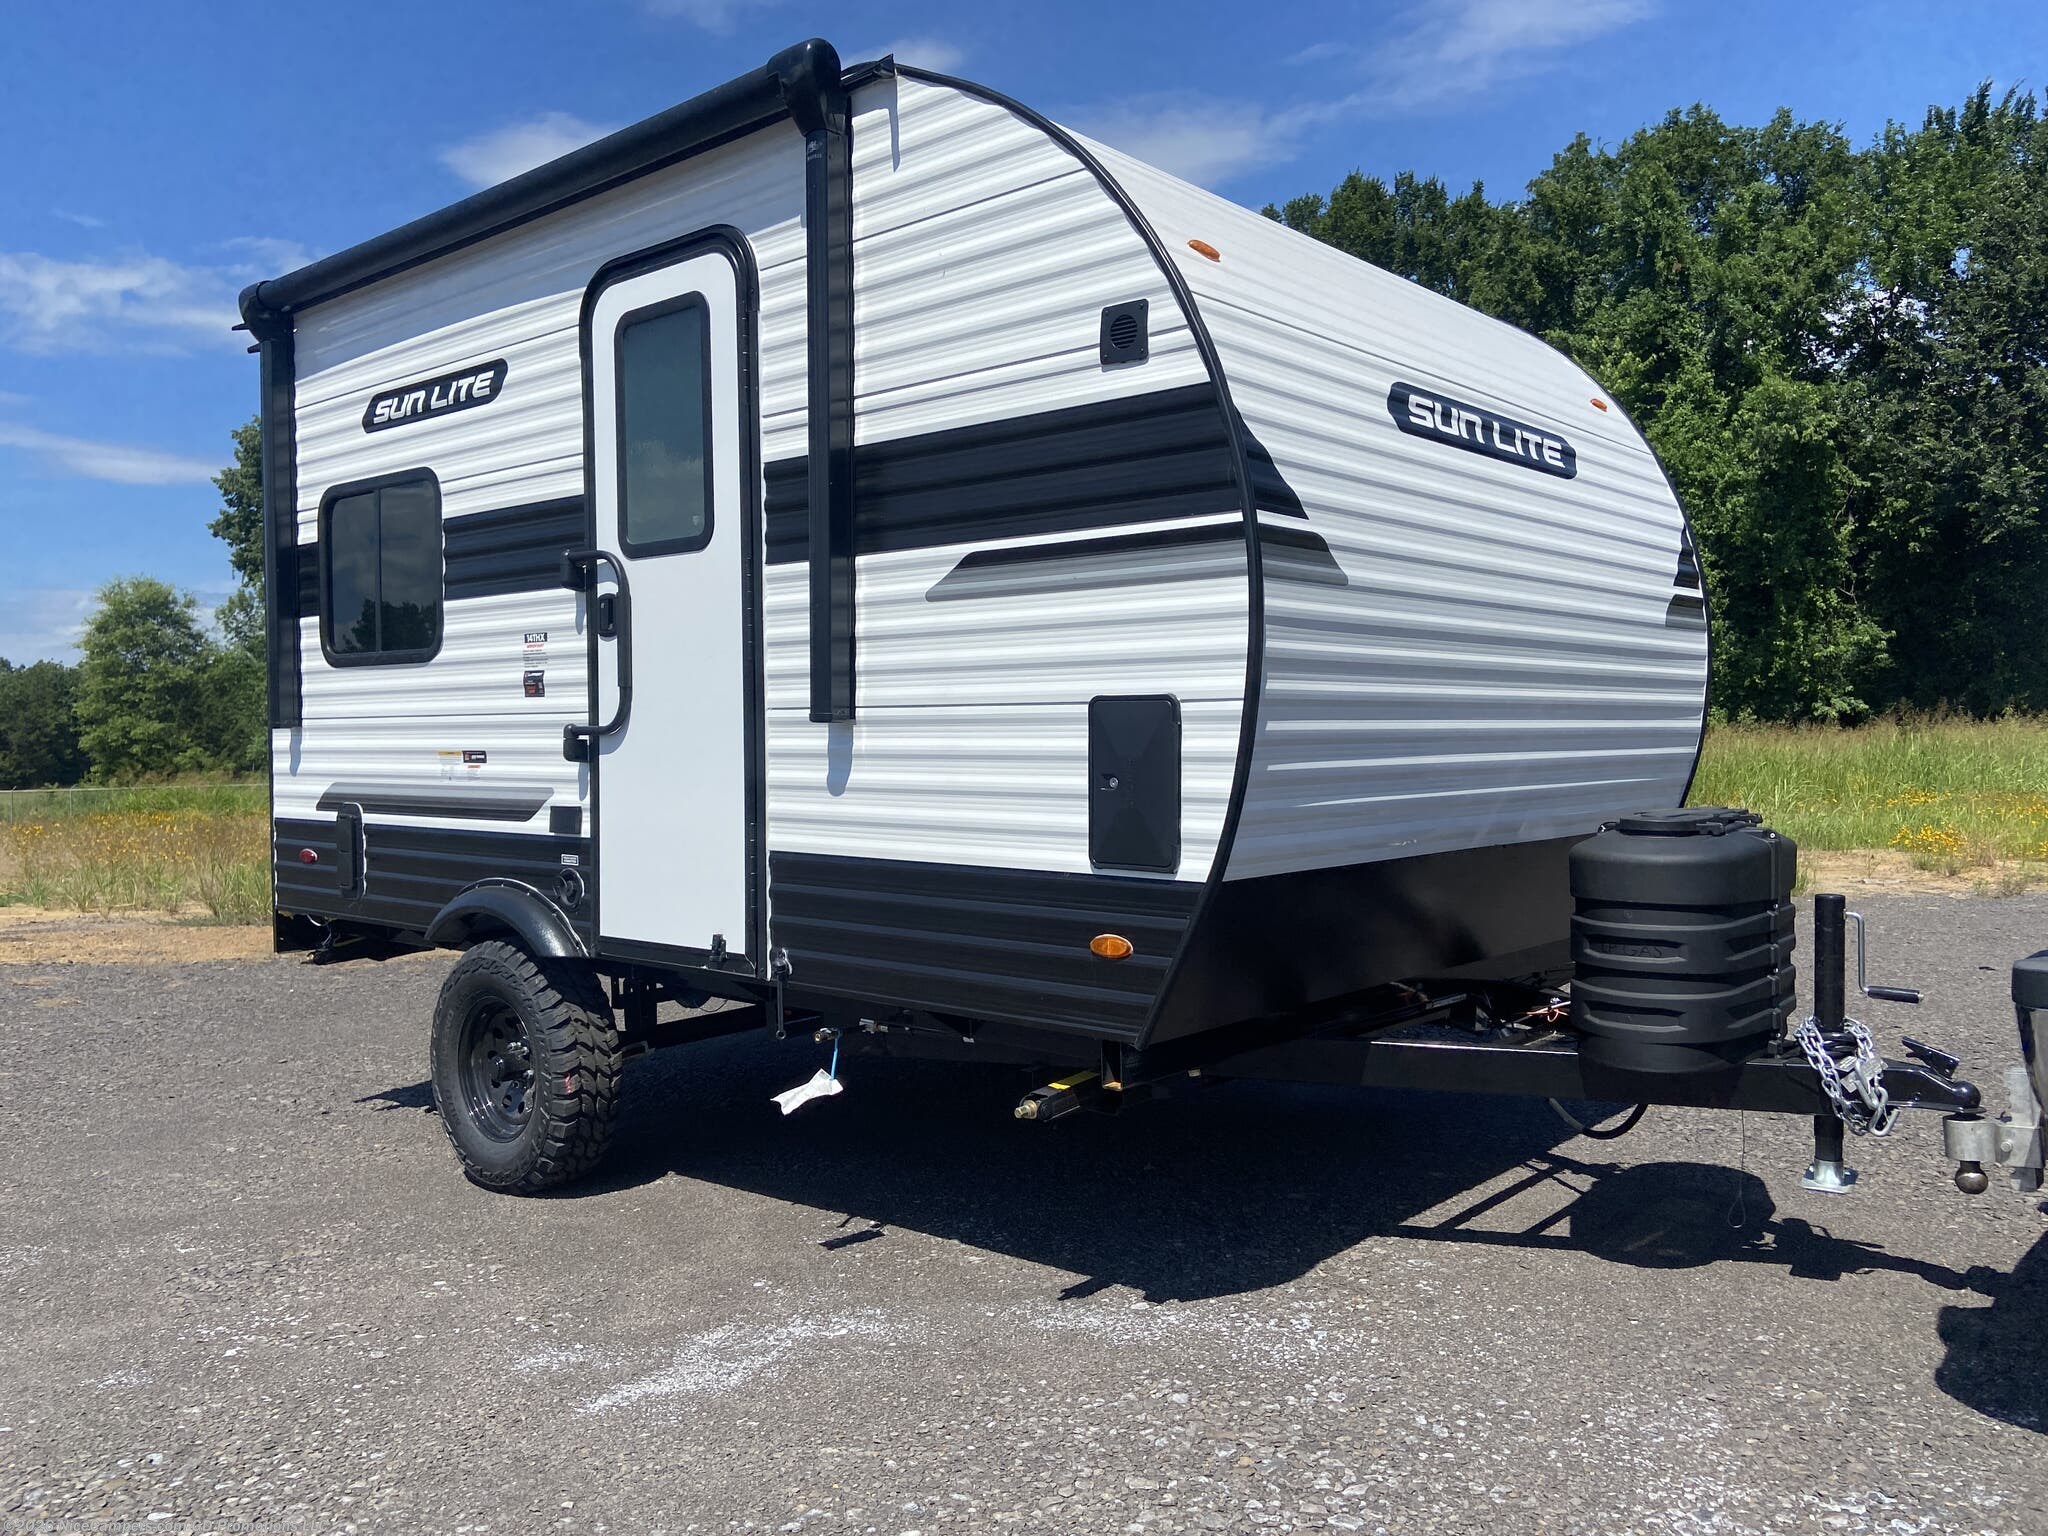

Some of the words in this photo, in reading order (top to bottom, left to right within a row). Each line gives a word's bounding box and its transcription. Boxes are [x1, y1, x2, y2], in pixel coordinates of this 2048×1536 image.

[373, 390, 426, 425] SUN
[430, 371, 495, 410] LITE
[1408, 394, 1485, 444] SUN
[1492, 420, 1566, 468] LITE
